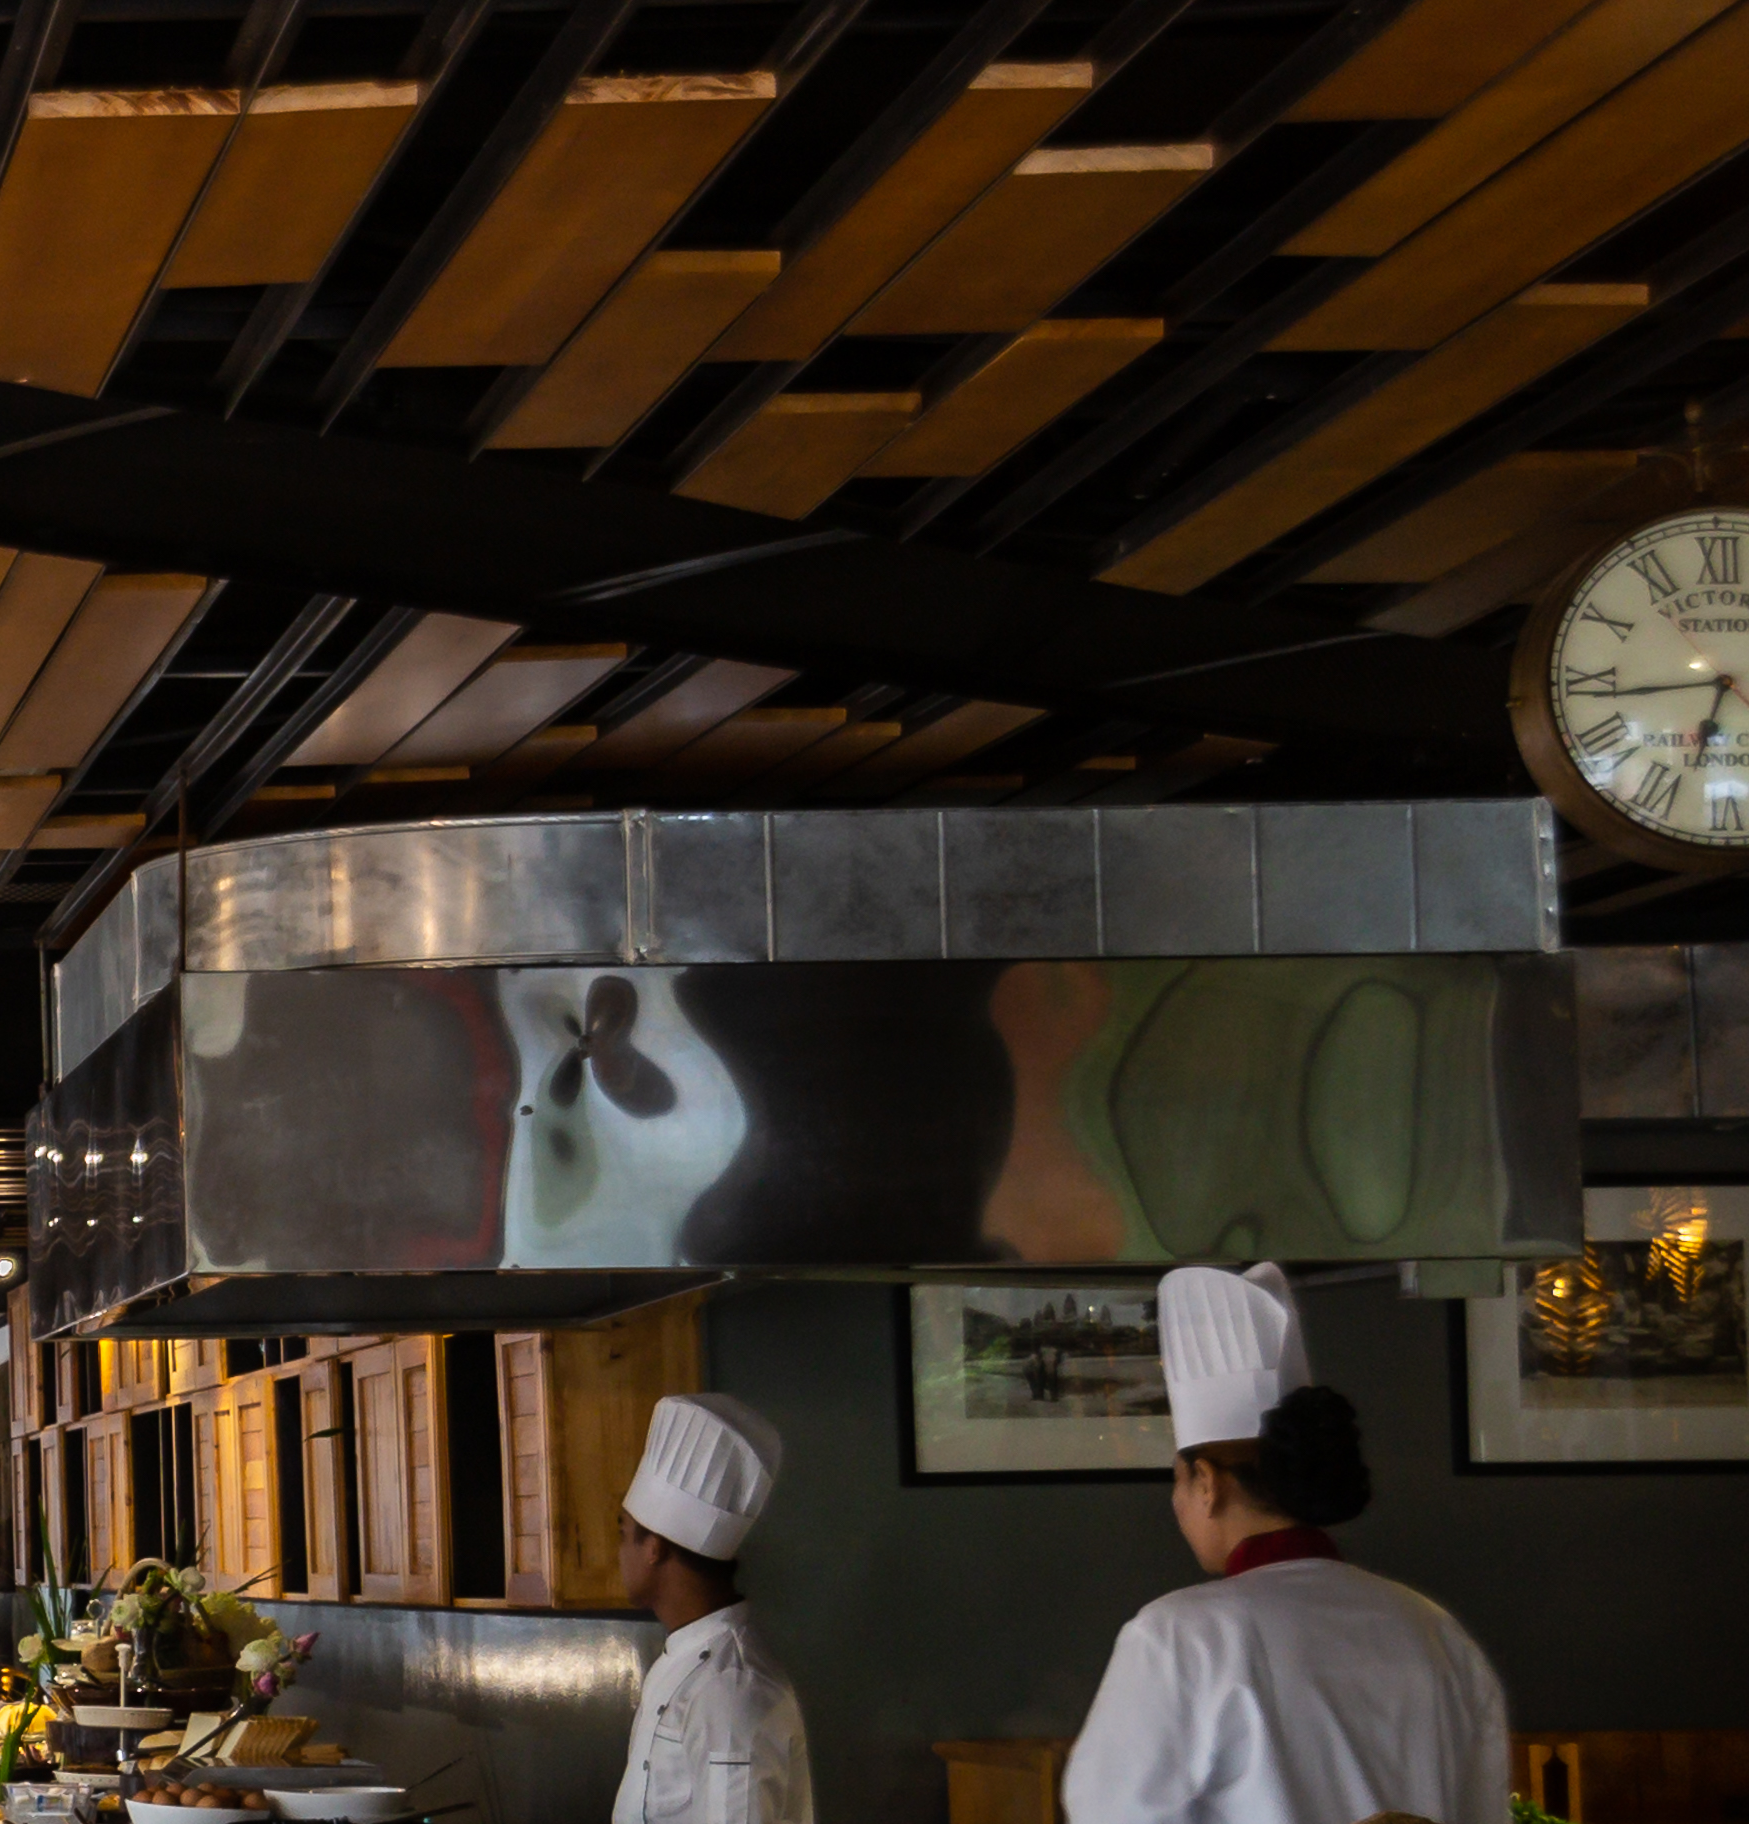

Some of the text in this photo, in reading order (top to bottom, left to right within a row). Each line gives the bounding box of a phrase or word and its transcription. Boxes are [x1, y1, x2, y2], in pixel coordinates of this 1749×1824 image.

[1625, 549, 1682, 606] XI
[1694, 536, 1740, 585] XII
[1580, 601, 1635, 644] X
[1565, 665, 1616, 698] IX
